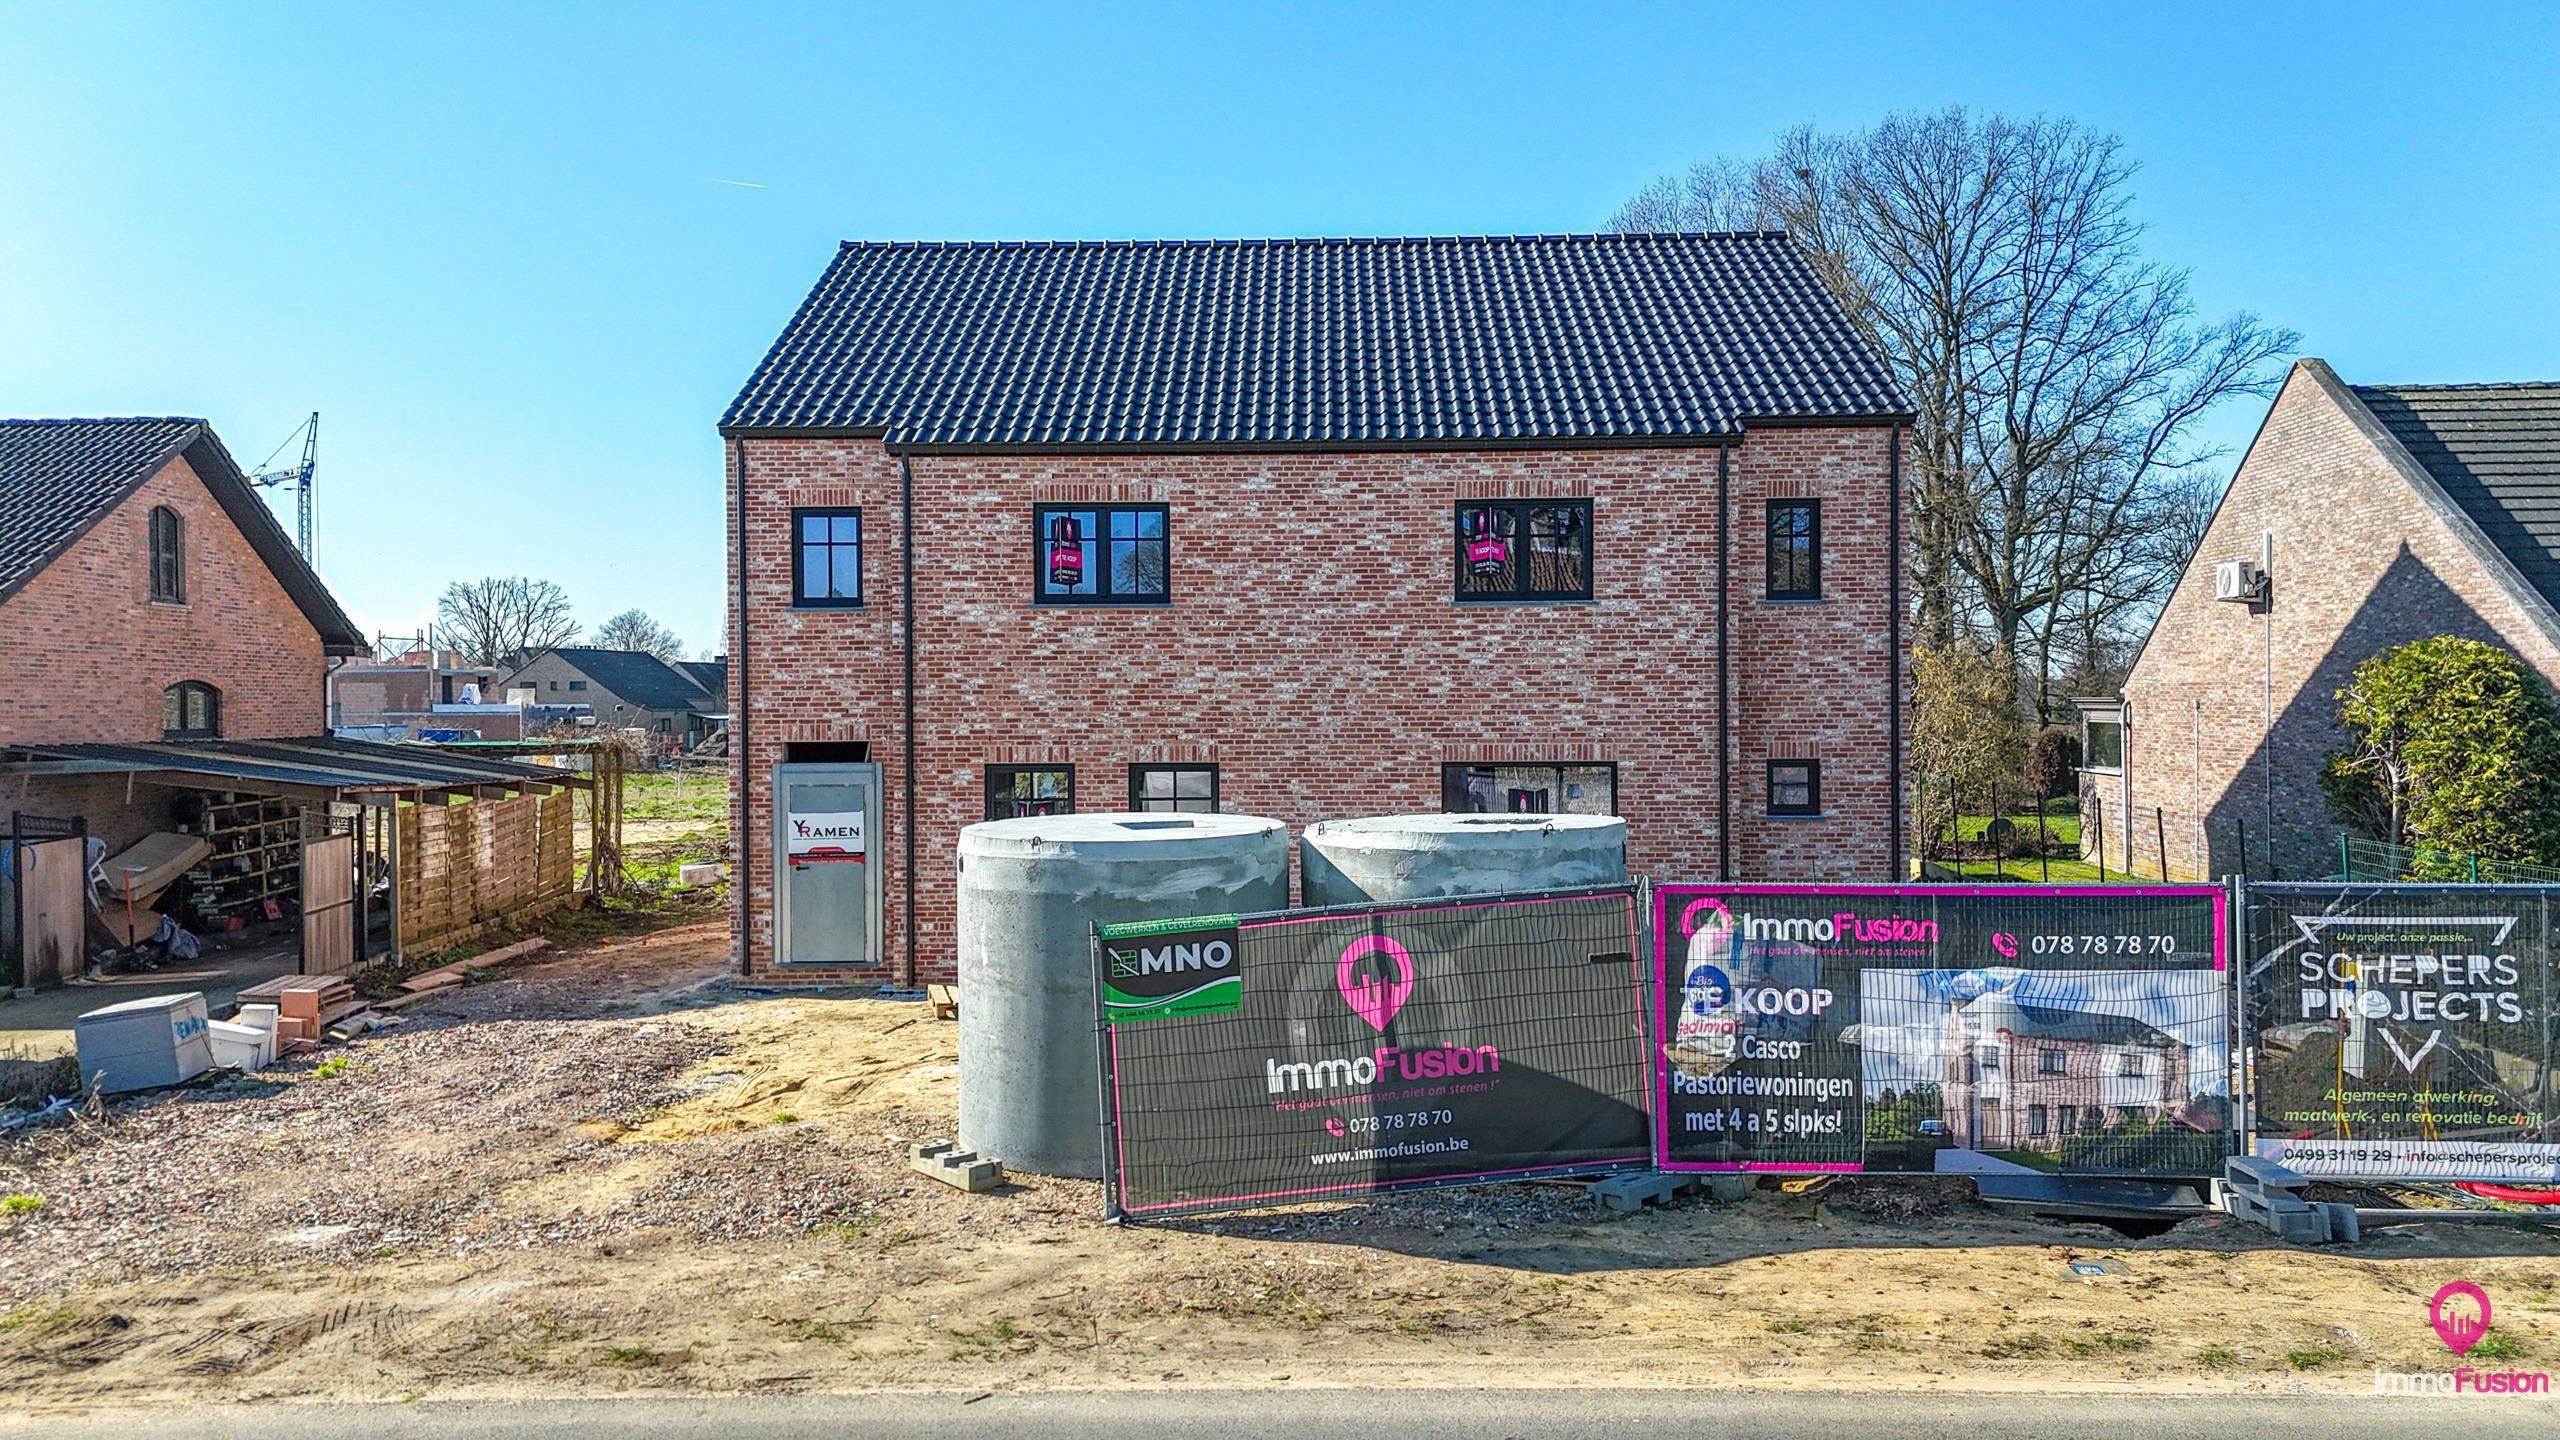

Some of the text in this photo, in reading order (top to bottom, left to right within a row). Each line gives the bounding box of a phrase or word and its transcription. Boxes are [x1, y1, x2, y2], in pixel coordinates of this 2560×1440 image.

[1103, 923, 1159, 936] VOEGWERKEN
[1168, 916, 1235, 930] GEVELRENOVATIE
[1744, 913, 1939, 942] ImmoFusion
[2336, 932, 2355, 941] Uw
[2357, 932, 2397, 943] project,
[2400, 933, 2426, 942] onze
[1141, 940, 1232, 975] MNO
[2032, 936, 2175, 954] 078 78 78 70
[2299, 951, 2519, 985] SCHEPERS
[1735, 987, 1834, 1015] KOOP
[2301, 988, 2523, 1023] PROJECTS
[1725, 1034, 1800, 1059] 2 Casco
[1267, 1042, 1499, 1093] ImmoFusion
[1403, 1087, 1424, 1098] niet
[1428, 1086, 1445, 1096] om
[1450, 1083, 1487, 1094] stenen
[1673, 1070, 1853, 1102] Pastoriewoningen
[2324, 1088, 2499, 1107] Algemeen afwerking,
[1350, 1109, 1452, 1133] 078 78 78 70
[1686, 1107, 1841, 1138] met 4 a 5 slpks!
[2381, 1112, 2401, 1123] en
[2405, 1110, 2481, 1124] renovatie
[2487, 1111, 2542, 1128] bedrijf
[1311, 1137, 1469, 1165] www.immofusion.be
[2284, 1149, 2325, 1161] 0499
[2329, 1149, 2346, 1161] 31
[2350, 1149, 2367, 1161] 19
[2372, 1149, 2392, 1161] 29
